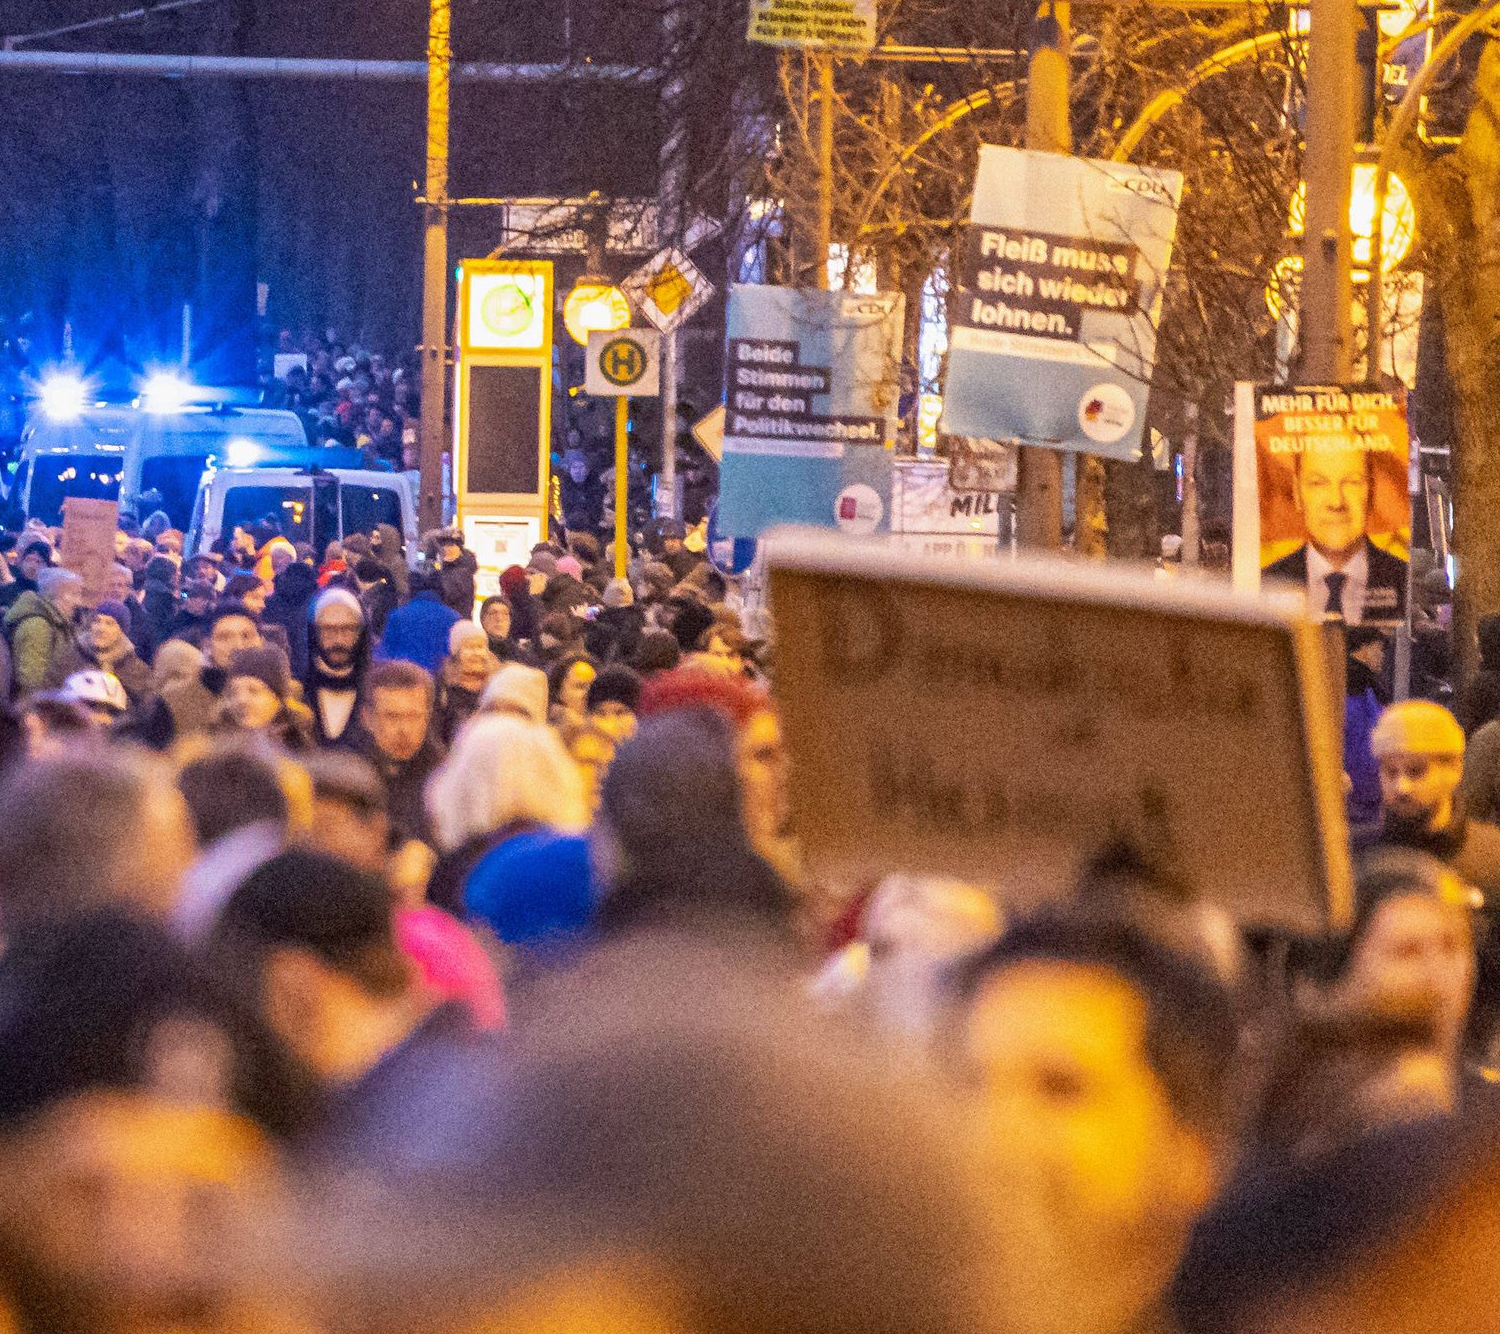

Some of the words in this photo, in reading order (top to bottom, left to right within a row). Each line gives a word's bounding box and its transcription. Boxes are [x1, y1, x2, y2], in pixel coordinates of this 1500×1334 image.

[980, 231, 1047, 263] Fleiß
[1051, 244, 1129, 274] muss
[977, 267, 1033, 297] sich
[1038, 277, 1129, 308] wieder
[971, 299, 1073, 335] lohnen.
[611, 349, 636, 375] H
[738, 343, 794, 364] Beide
[737, 368, 826, 389] Stimmen
[735, 392, 764, 410] für
[767, 393, 806, 412] den
[1262, 395, 1312, 413] MEHR
[1316, 392, 1347, 413] FÜR
[1352, 393, 1397, 412] DICH.
[734, 417, 881, 439] Politikwechsel.
[1285, 415, 1342, 433] BESSER
[1347, 412, 1378, 433] FÜR
[1269, 434, 1396, 454] DEUTSCHLAND.
